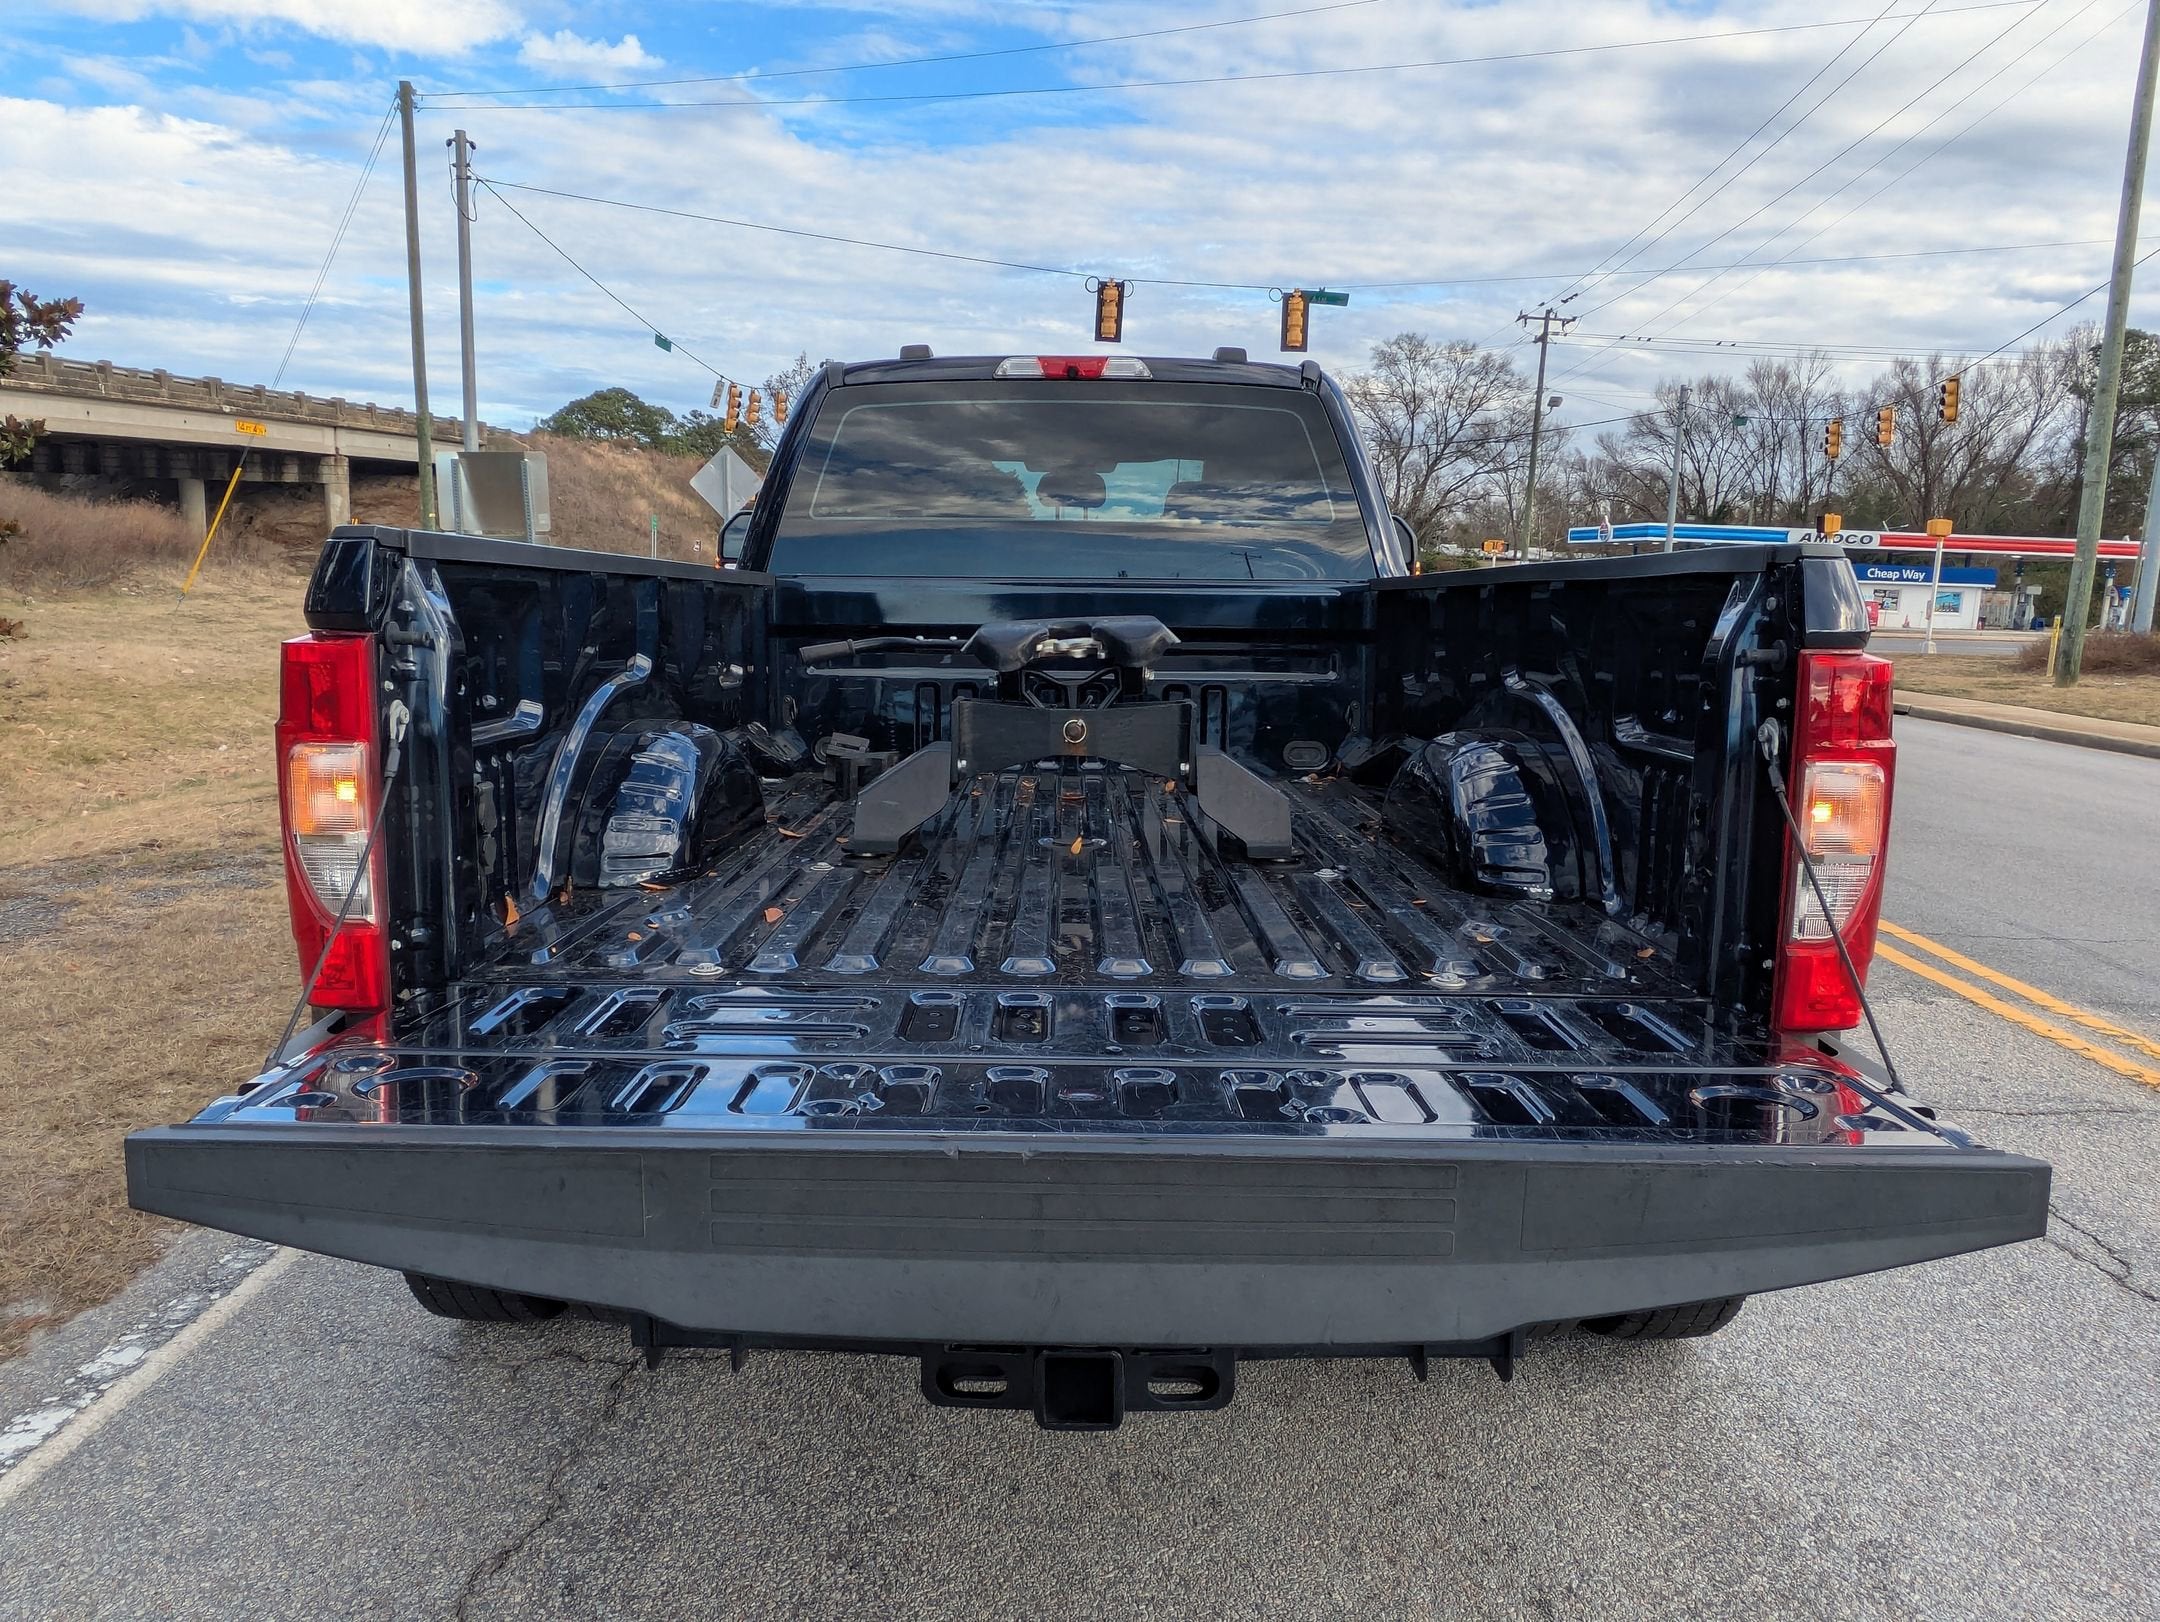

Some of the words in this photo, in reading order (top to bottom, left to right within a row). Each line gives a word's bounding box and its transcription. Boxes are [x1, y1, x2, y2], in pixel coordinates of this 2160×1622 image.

[1799, 532, 1874, 544] AMOCO
[1867, 567, 1899, 580] Cheap
[1902, 568, 1926, 582] Way
